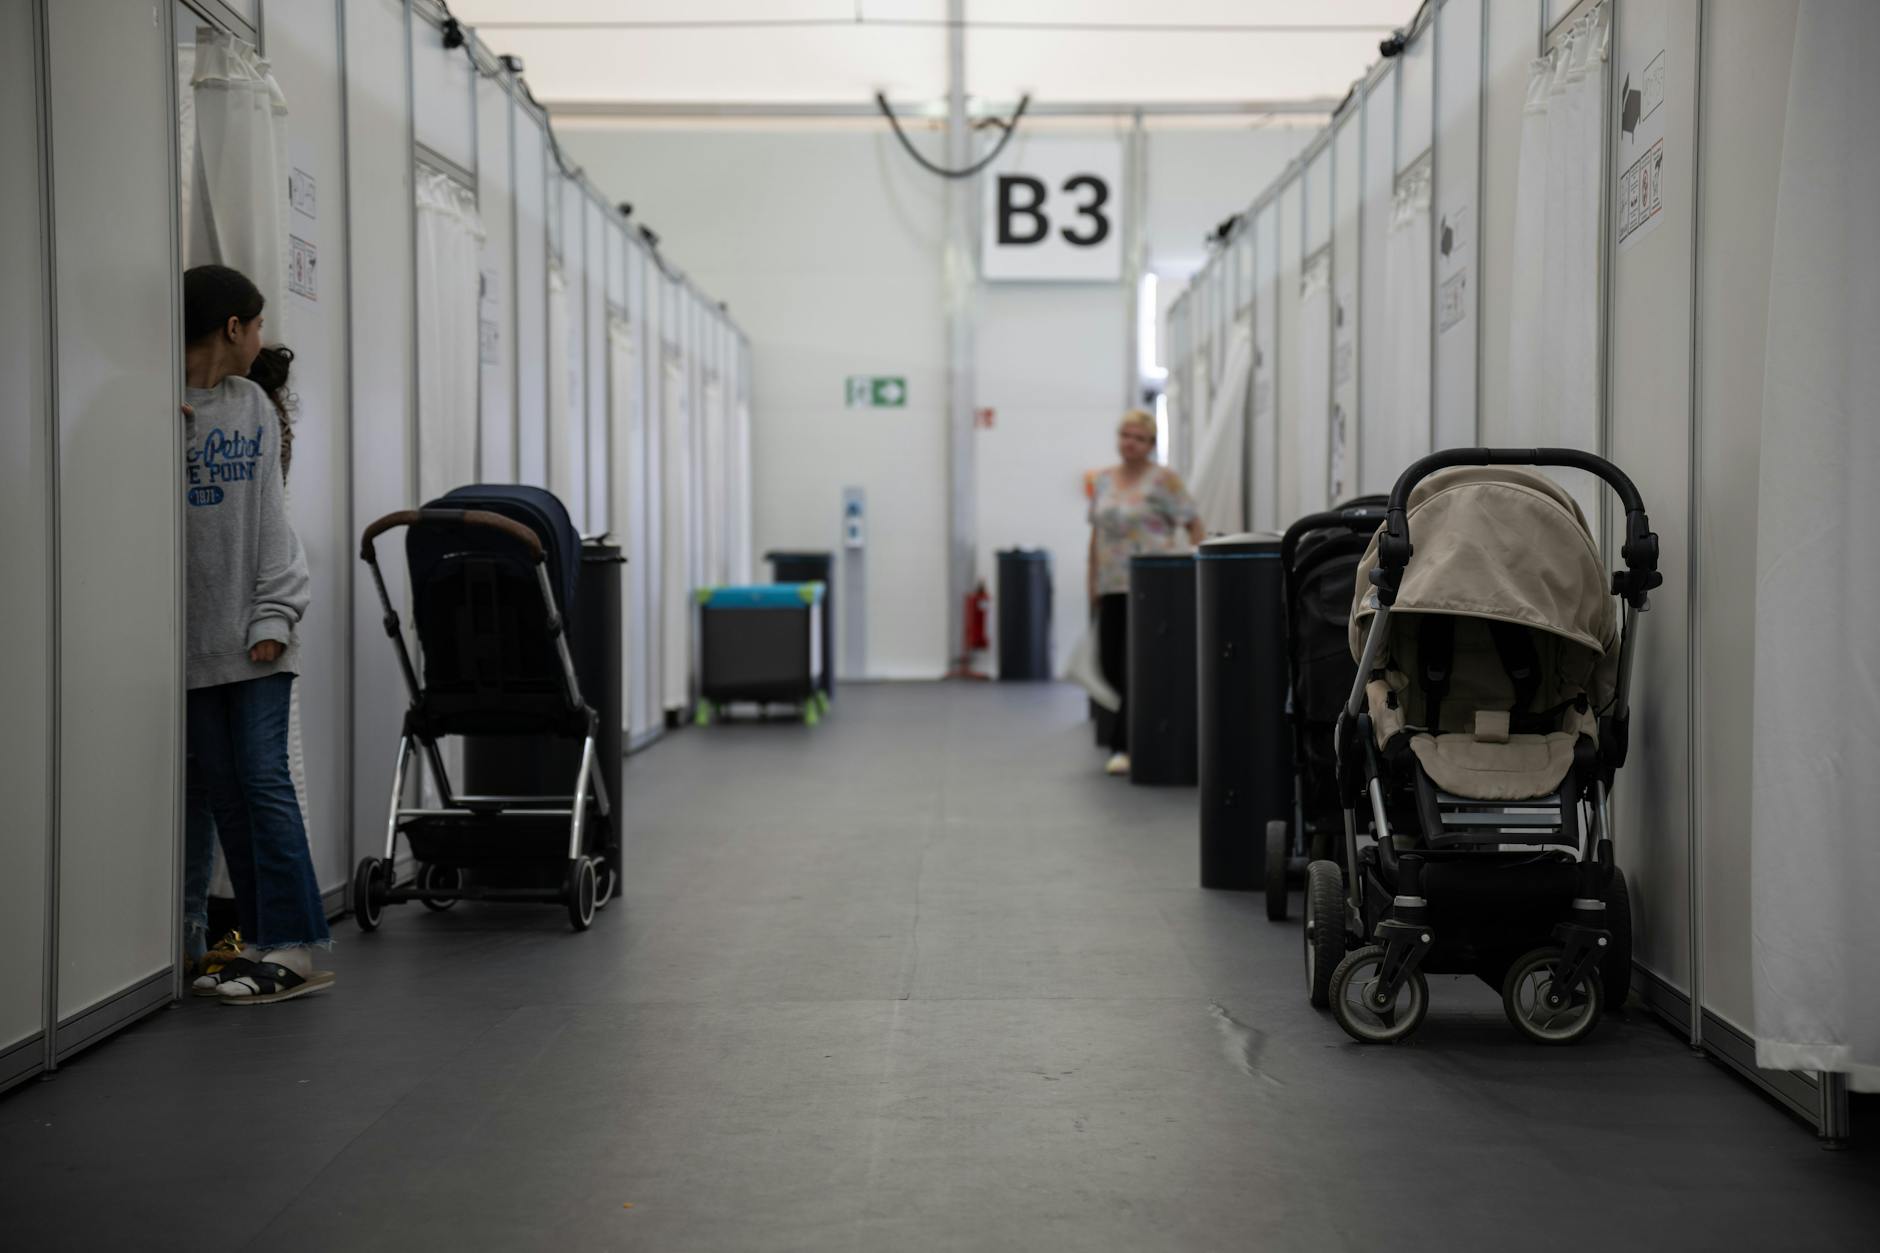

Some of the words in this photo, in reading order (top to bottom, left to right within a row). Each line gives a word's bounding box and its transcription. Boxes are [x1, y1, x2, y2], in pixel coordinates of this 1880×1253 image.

[997, 175, 1109, 246] B3
[204, 426, 263, 468] Petrol
[209, 461, 256, 483] POINT
